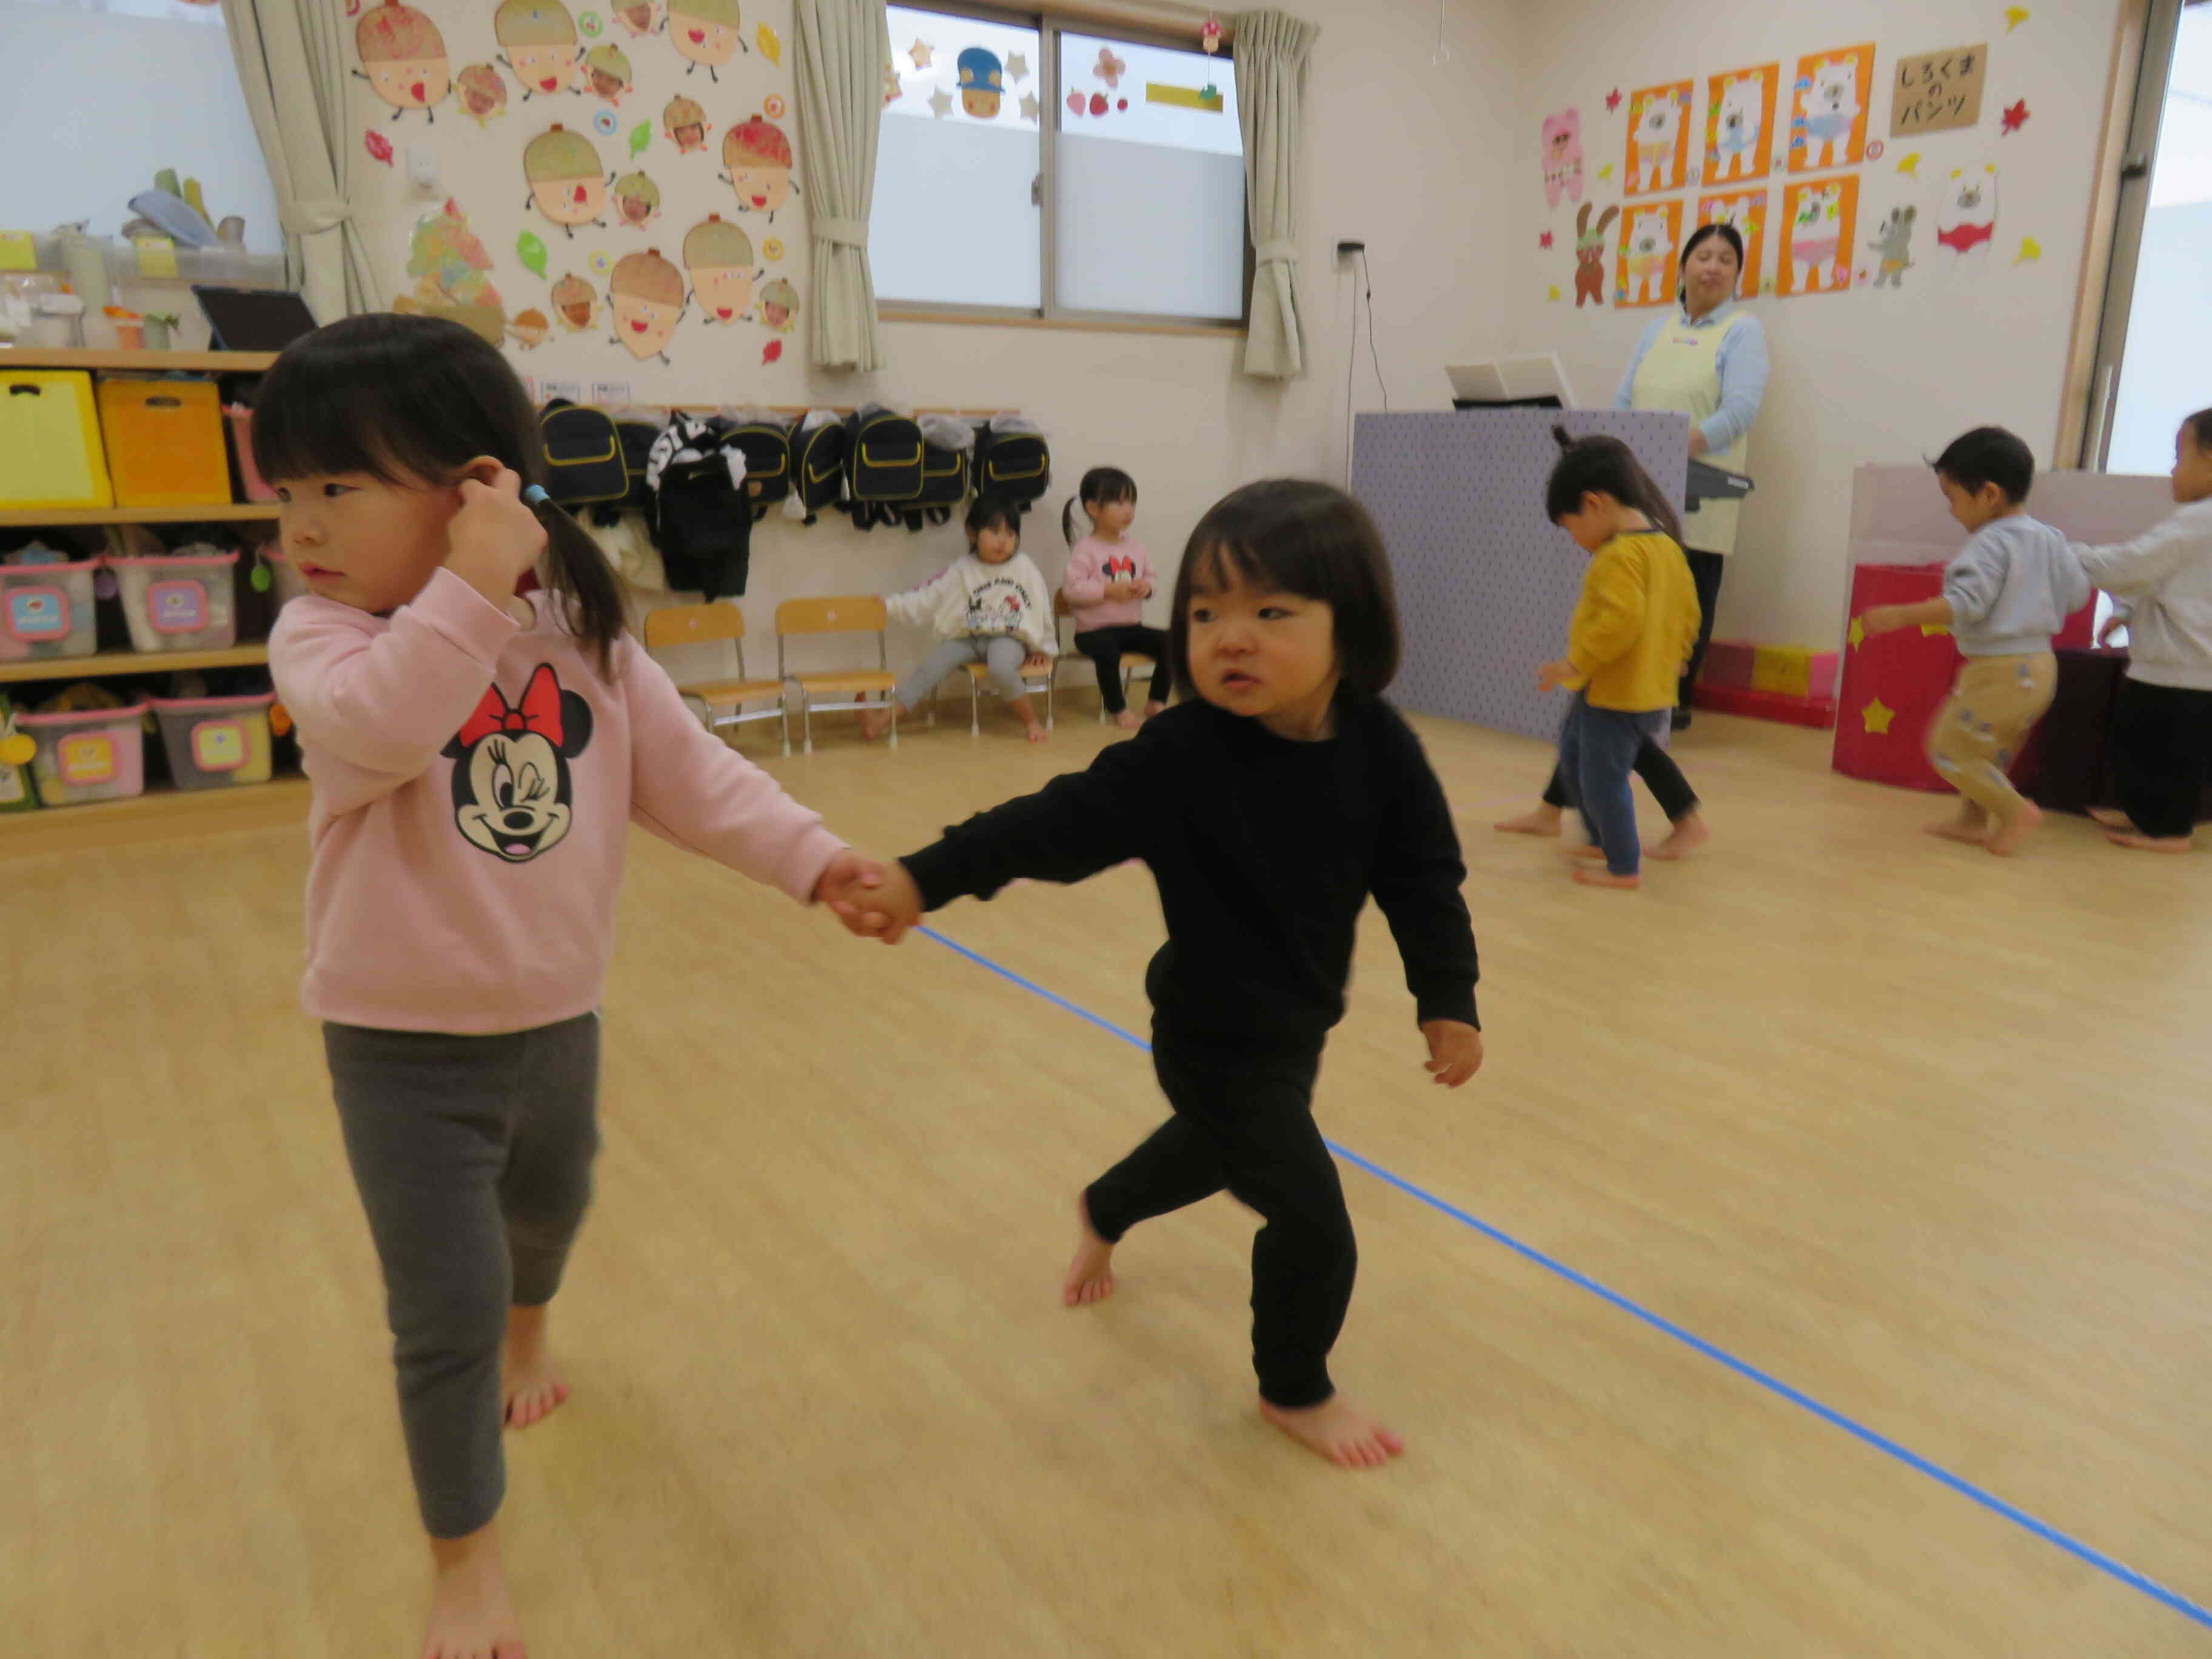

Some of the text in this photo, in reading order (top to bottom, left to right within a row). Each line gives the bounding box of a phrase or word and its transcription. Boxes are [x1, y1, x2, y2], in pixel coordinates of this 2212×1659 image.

[1901, 55, 1975, 87] しろくま
[1928, 82, 1942, 98] の
[1901, 95, 1966, 125] パンツ
